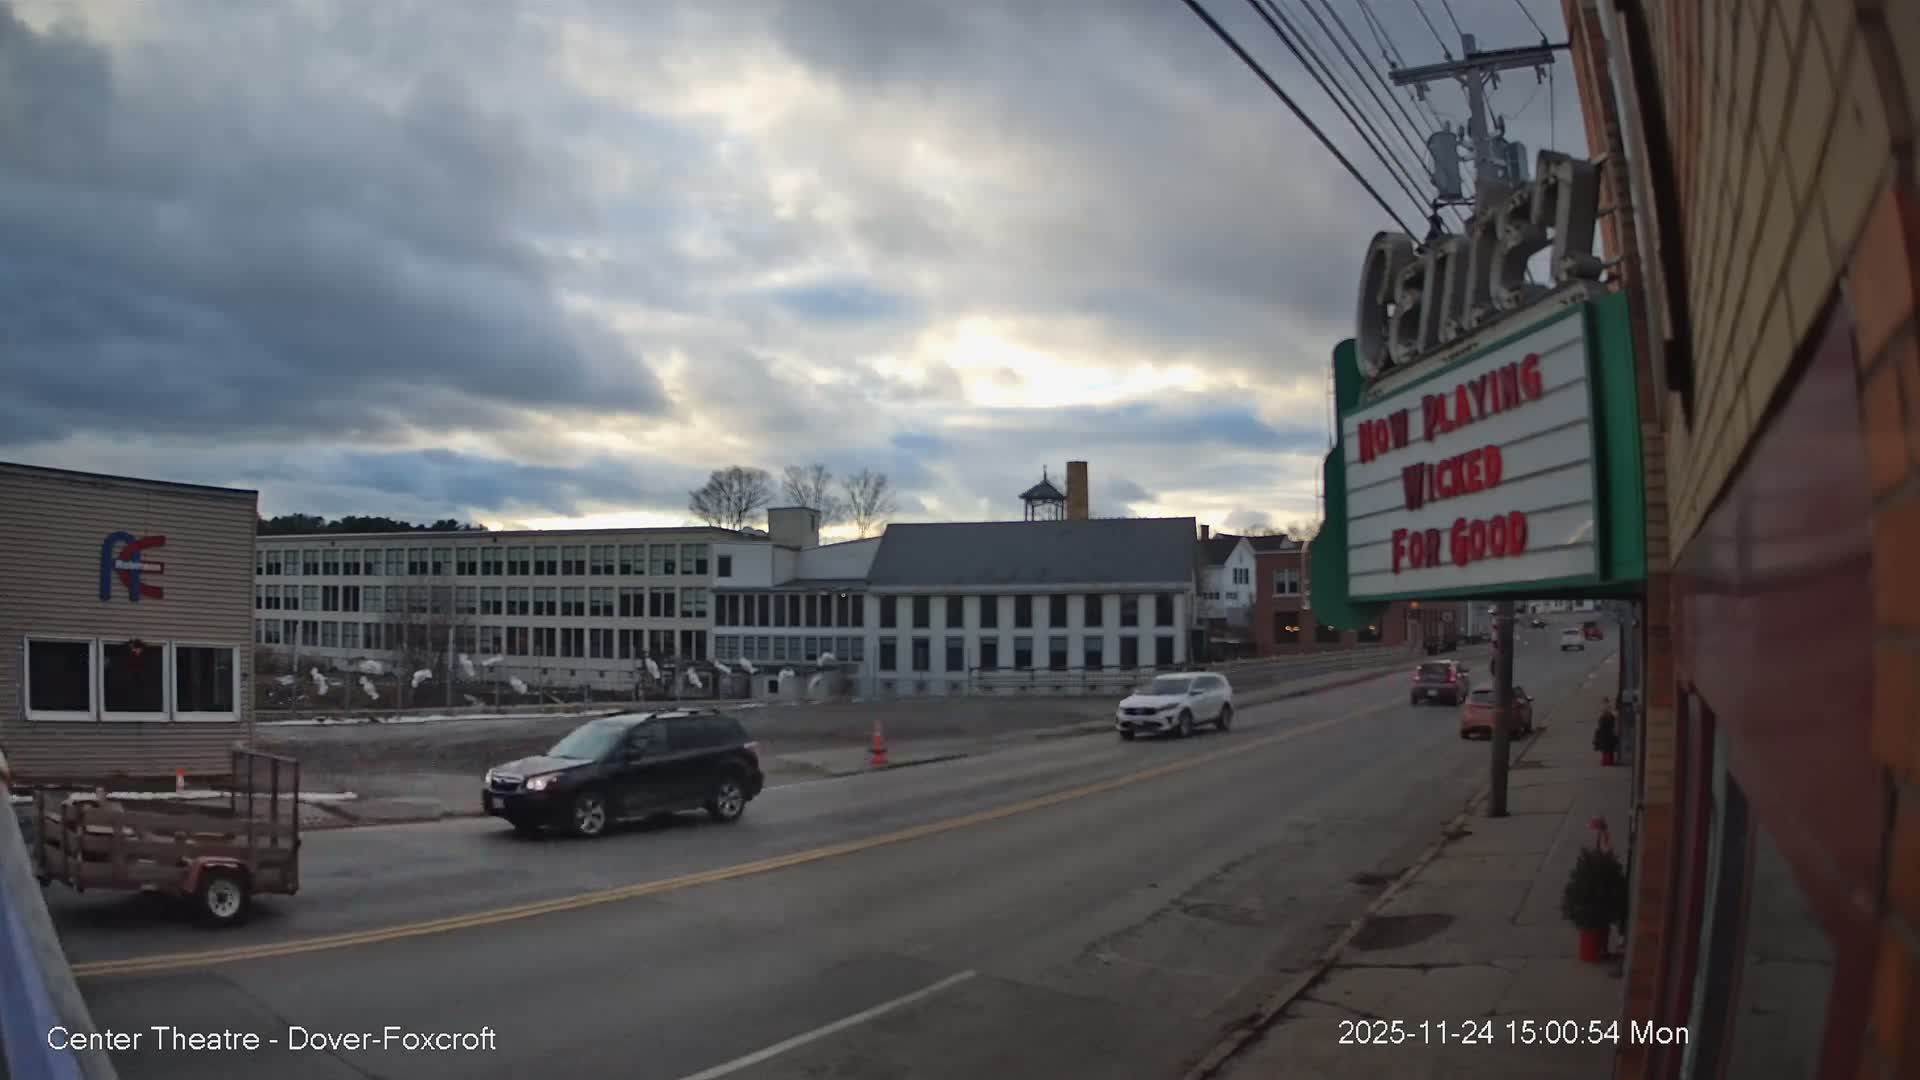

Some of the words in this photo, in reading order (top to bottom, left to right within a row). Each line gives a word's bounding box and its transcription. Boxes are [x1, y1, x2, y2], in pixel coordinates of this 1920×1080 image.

[1357, 408, 1409, 464] NOW
[1422, 352, 1543, 442] PLAYING
[1401, 444, 1503, 512] WICKED
[1391, 528, 1441, 574] FOR
[1449, 510, 1528, 567] GOOD
